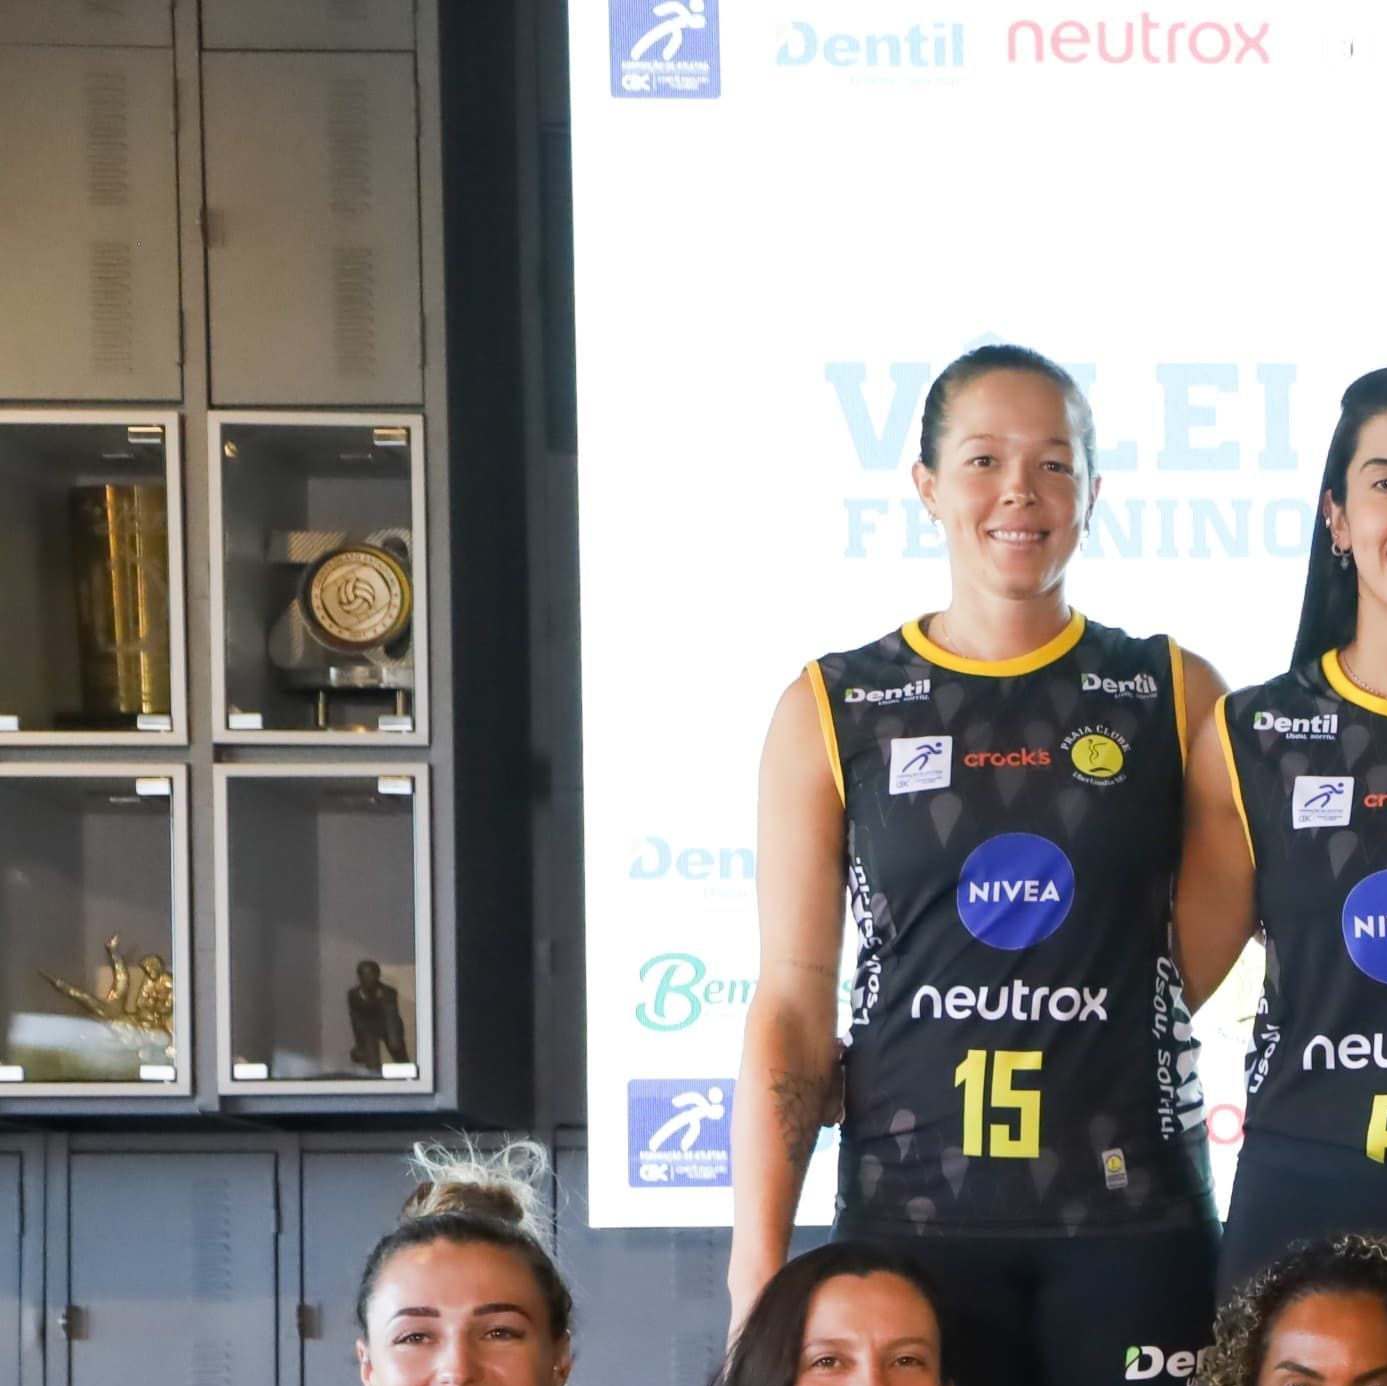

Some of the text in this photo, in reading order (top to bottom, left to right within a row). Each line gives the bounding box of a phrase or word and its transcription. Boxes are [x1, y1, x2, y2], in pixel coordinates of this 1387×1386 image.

[775, 20, 965, 68] Dentil
[1007, 11, 1271, 64] neutrox
[843, 497, 1313, 559] FENINO
[845, 678, 931, 704] Dentil
[1081, 673, 1158, 694] Dentil
[1060, 724, 1132, 752] PRAIA CLUBE
[1253, 711, 1338, 733] Dentil
[969, 879, 1061, 902] NIVEA
[911, 979, 1108, 1022] neutrox
[954, 1048, 1043, 1158] 15
